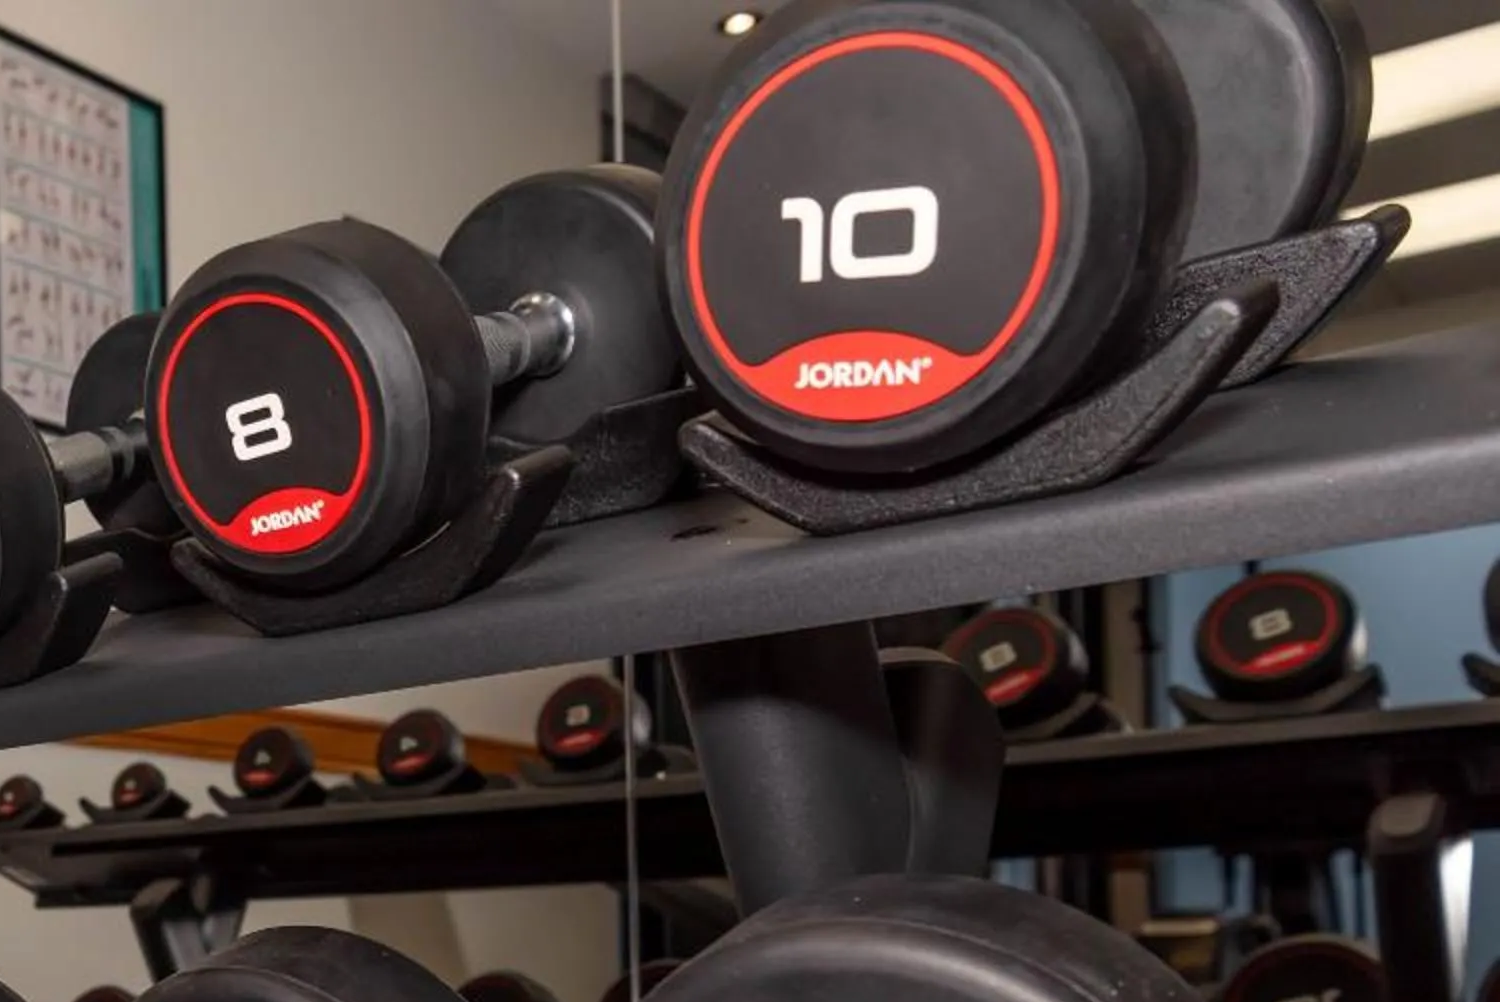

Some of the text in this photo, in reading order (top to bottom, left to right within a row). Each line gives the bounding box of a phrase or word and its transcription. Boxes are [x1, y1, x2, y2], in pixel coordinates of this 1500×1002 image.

[782, 186, 939, 283] 10
[794, 356, 922, 390] JORDAN
[225, 393, 293, 462] 8
